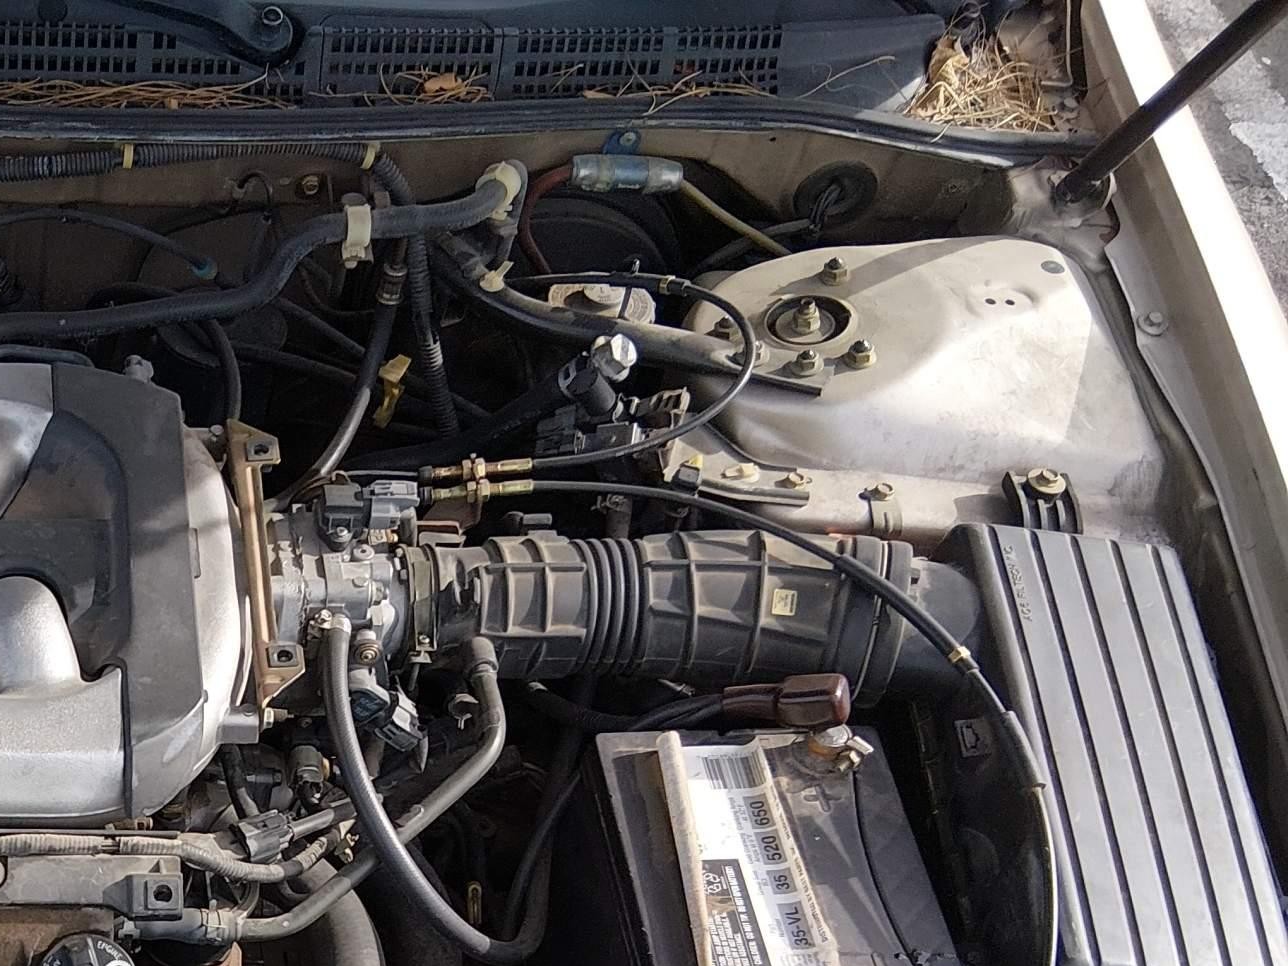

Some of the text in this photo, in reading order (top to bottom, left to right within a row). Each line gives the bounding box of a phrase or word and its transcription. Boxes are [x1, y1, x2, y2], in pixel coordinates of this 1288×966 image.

[749, 799, 770, 827] 650
[760, 834, 782, 861] 520
[772, 873, 789, 891] 35
[784, 906, 808, 946] 35-VL
[97, 940, 123, 960] ENGINE
